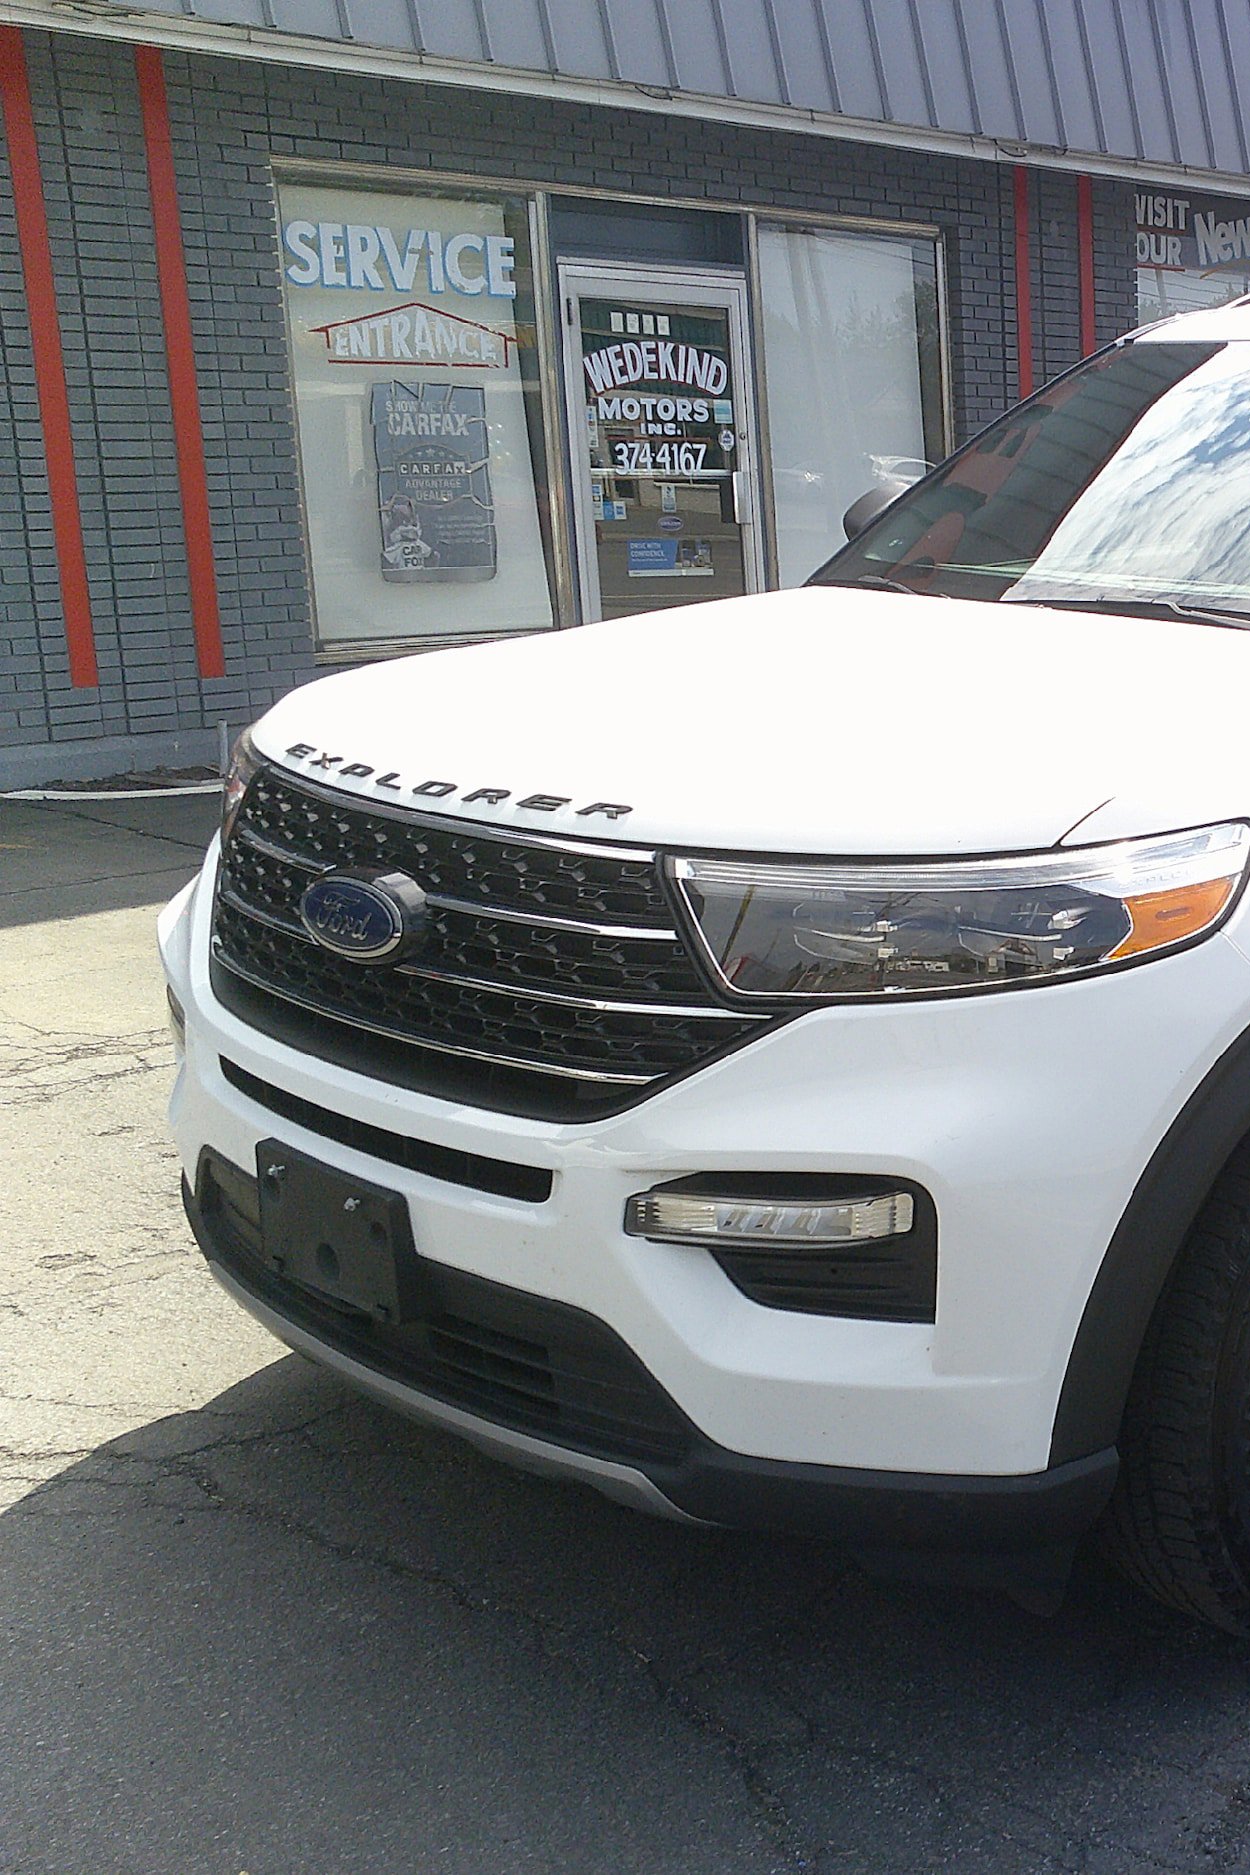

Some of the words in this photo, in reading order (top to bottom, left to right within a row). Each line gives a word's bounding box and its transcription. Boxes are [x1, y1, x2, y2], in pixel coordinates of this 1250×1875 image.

[1135, 193, 1190, 230] VISIT
[285, 220, 517, 298] SERVICE
[1136, 232, 1182, 265] OUR
[335, 310, 497, 360] ENTRANCE
[582, 341, 728, 396] WEDEKIND
[437, 401, 457, 413] TE
[597, 396, 710, 423] MOTORS
[387, 412, 470, 436] CARFAX
[640, 422, 682, 436] INC.
[400, 463, 465, 475] CARFAX
[405, 478, 462, 489] ADVANTAGE
[415, 489, 453, 501] DEALER
[402, 545, 422, 556] CAR
[284, 742, 634, 820] EXPLORER
[315, 890, 373, 942] Ford
